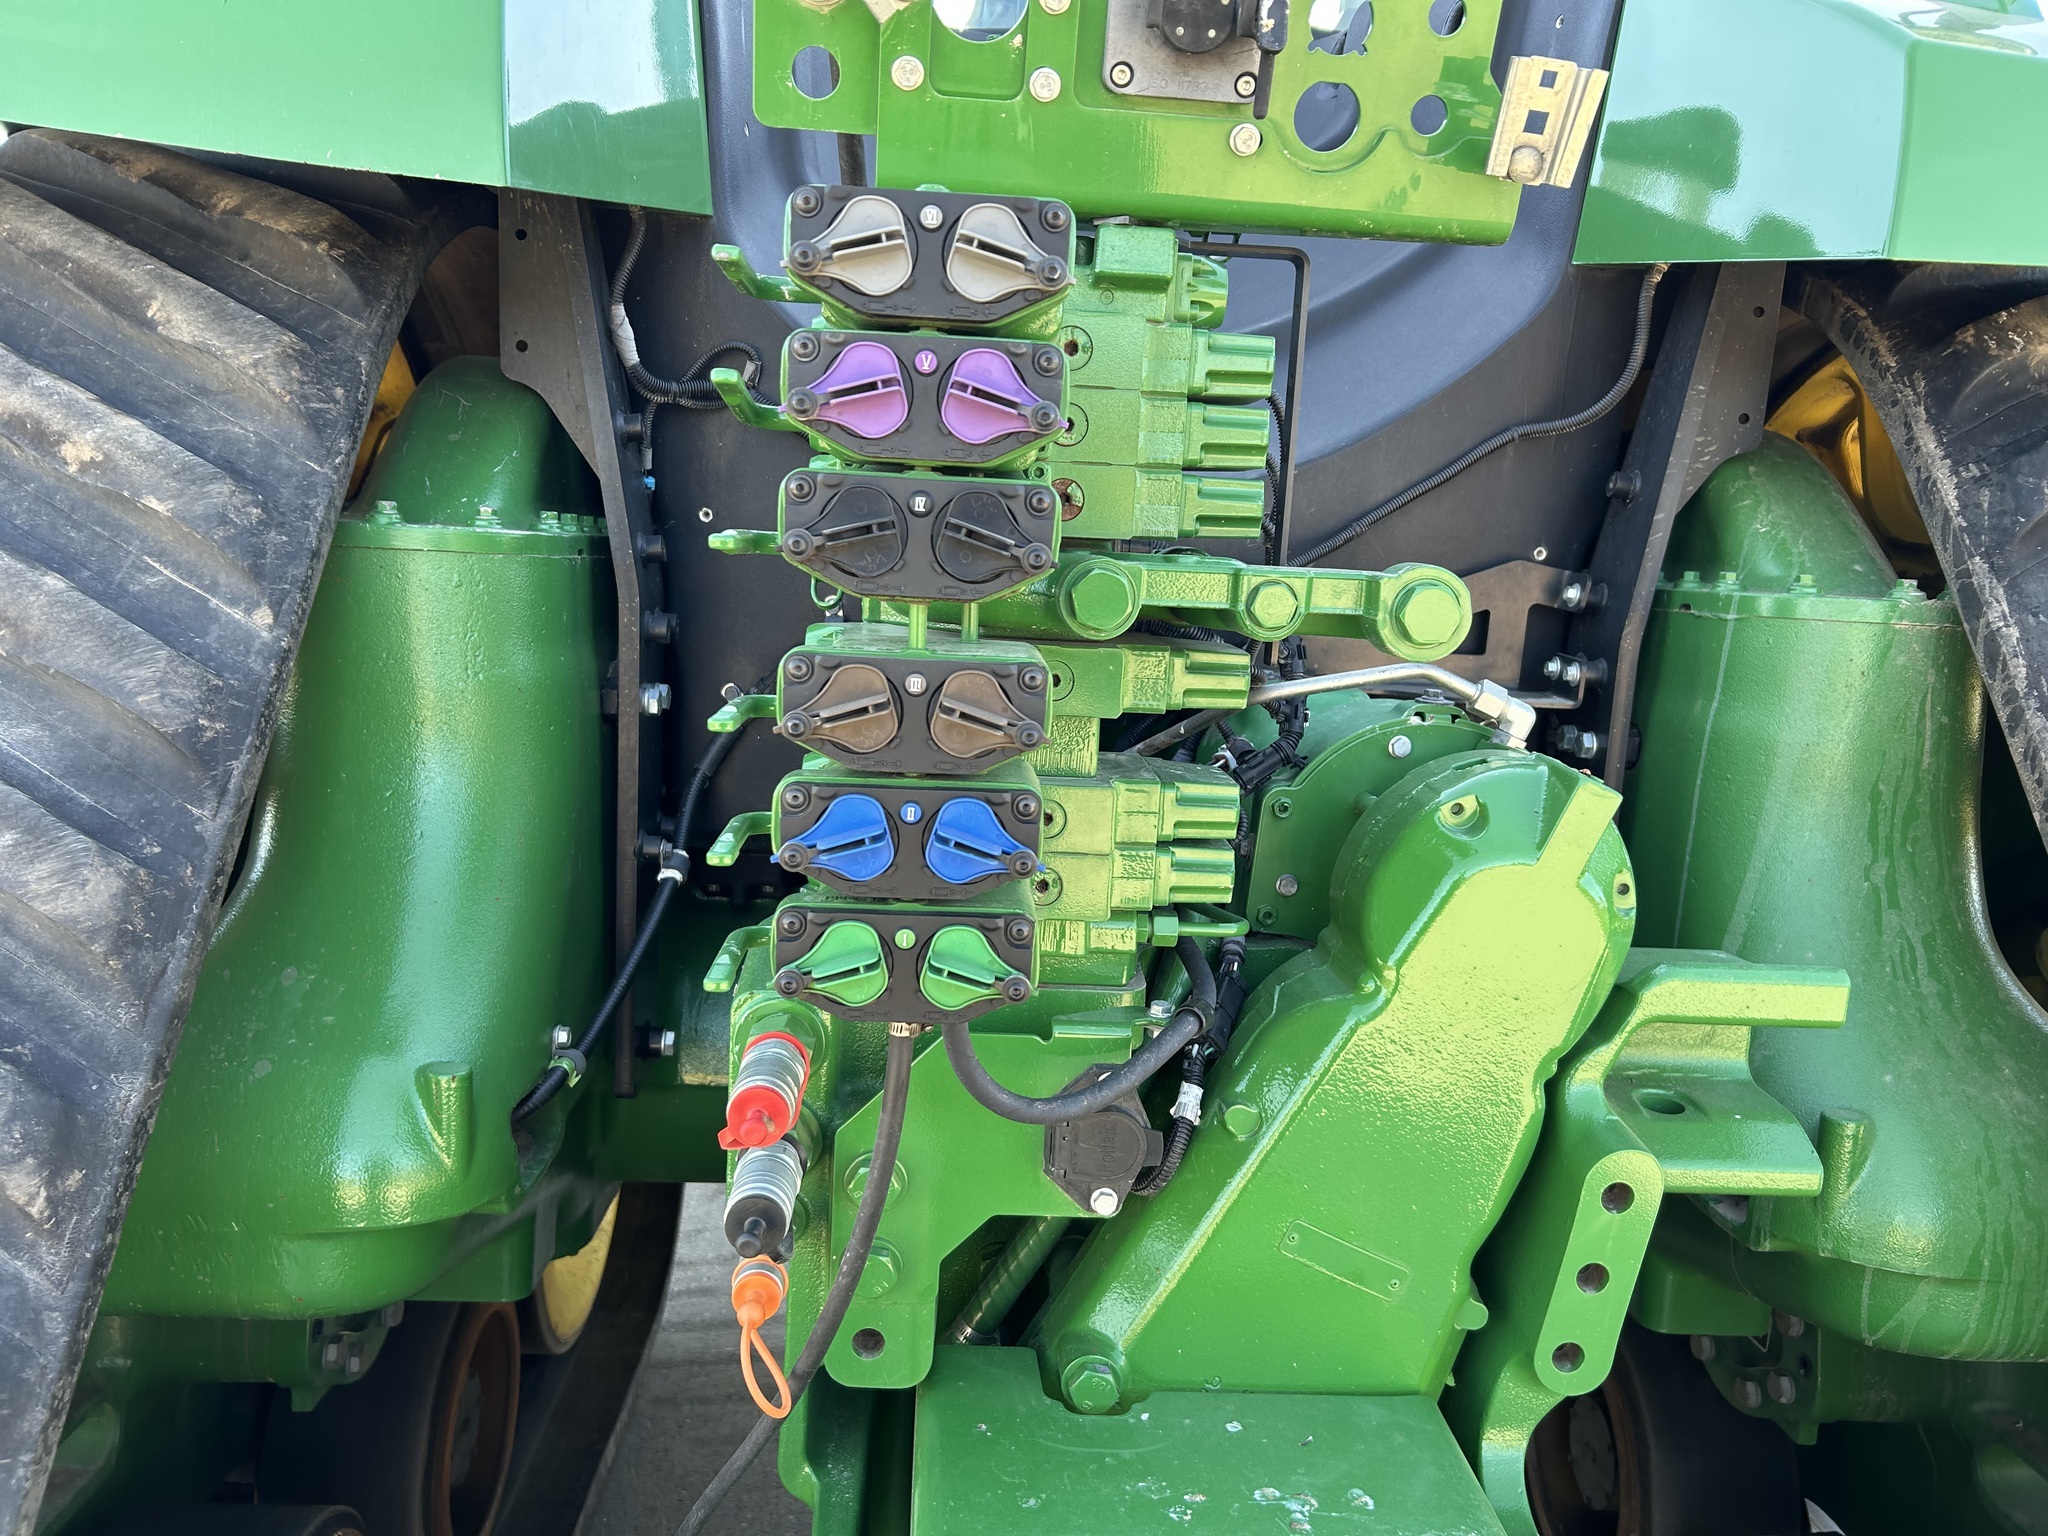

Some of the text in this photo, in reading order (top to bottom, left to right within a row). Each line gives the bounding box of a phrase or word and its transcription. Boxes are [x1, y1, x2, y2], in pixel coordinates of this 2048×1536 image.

[925, 208, 938, 224] VI
[920, 353, 933, 370] V
[914, 496, 927, 511] IV
[909, 677, 922, 692] III
[906, 806, 916, 821] II
[1097, 1123, 1118, 1173] Pollak
